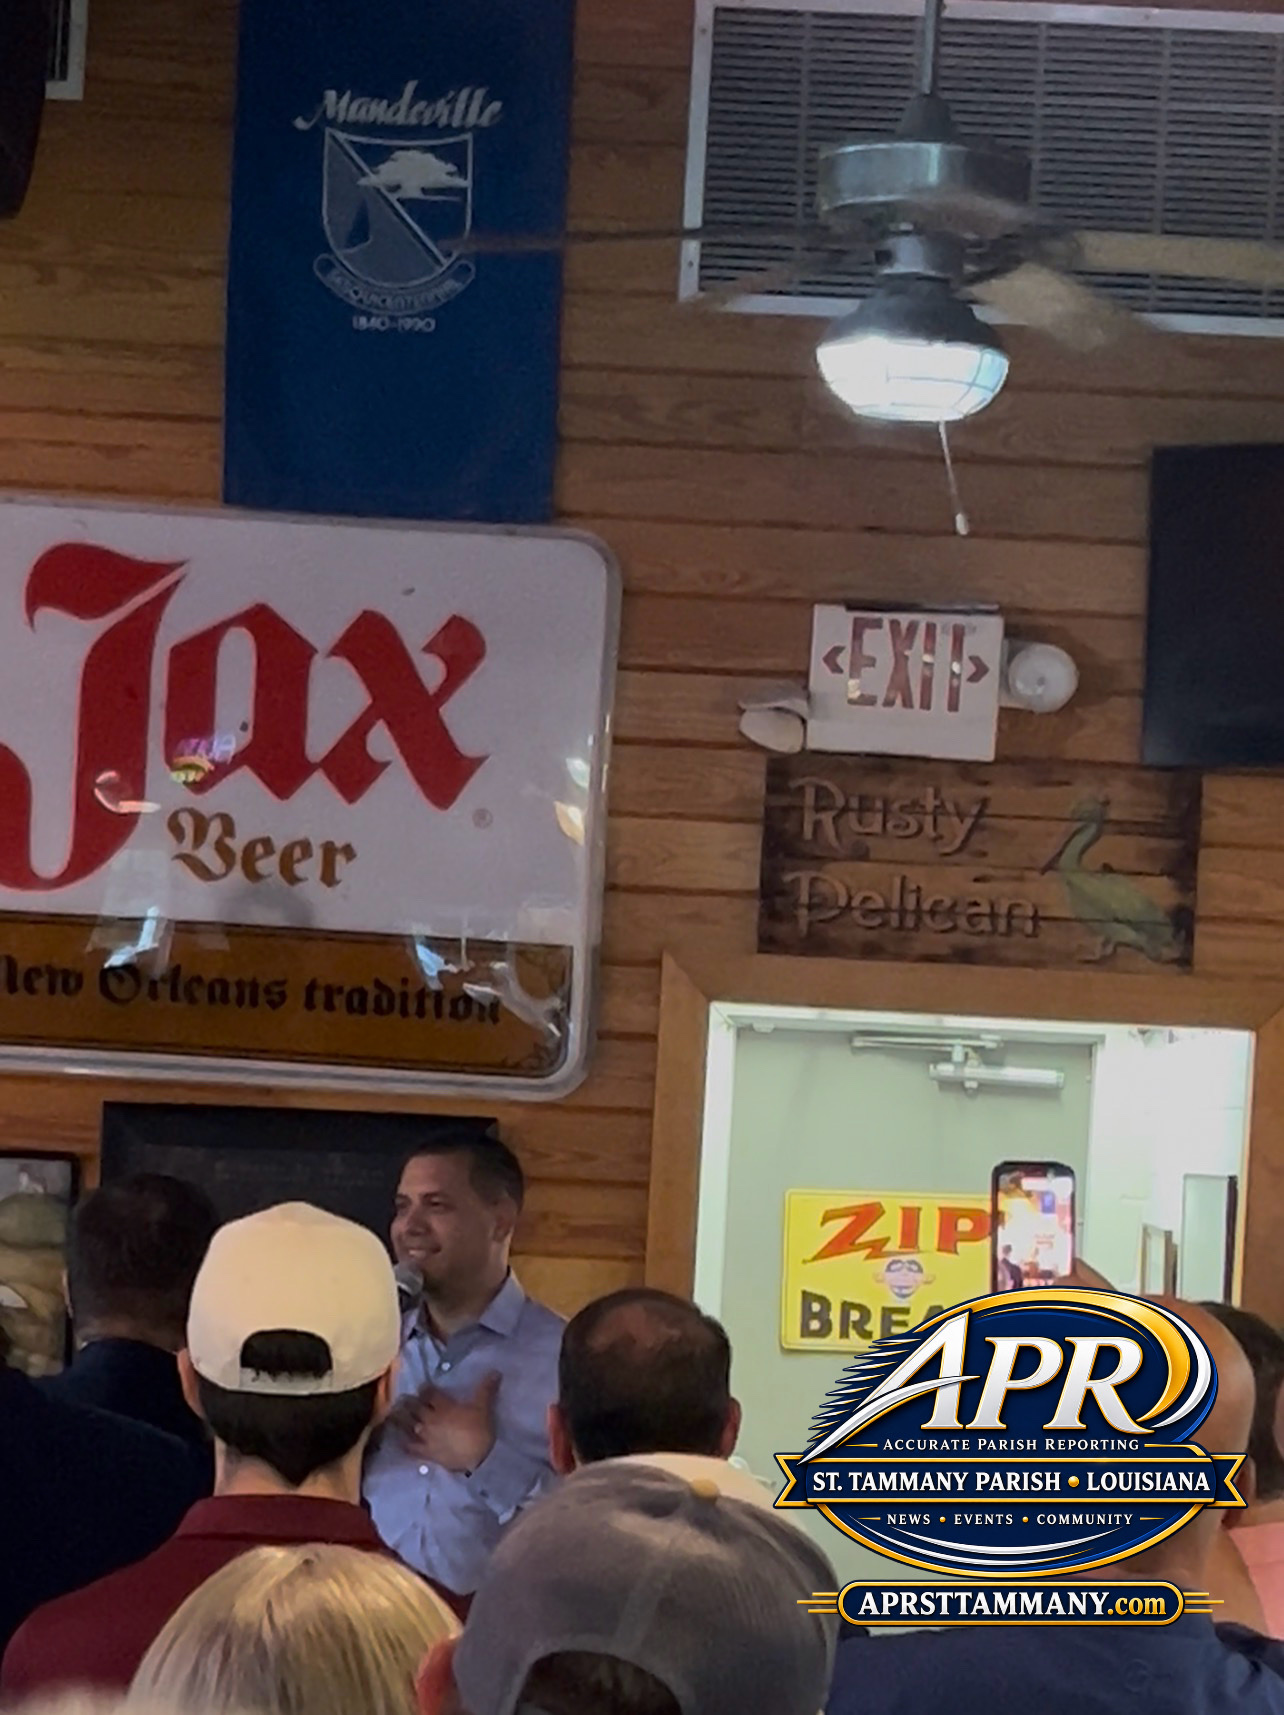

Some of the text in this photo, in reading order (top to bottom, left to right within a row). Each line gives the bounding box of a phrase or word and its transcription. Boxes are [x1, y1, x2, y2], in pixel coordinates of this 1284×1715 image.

[293, 79, 502, 130] Mandeville
[352, 316, 436, 333] 1840-1990
[847, 616, 976, 713] EXIT
[0, 542, 490, 892] Jax
[166, 806, 357, 889] Beer
[789, 775, 990, 858] Rusty
[784, 869, 1041, 940] Pelican
[99, 960, 290, 1012] Orleans
[302, 976, 502, 1026] tradition
[803, 1201, 992, 1266] ZIP
